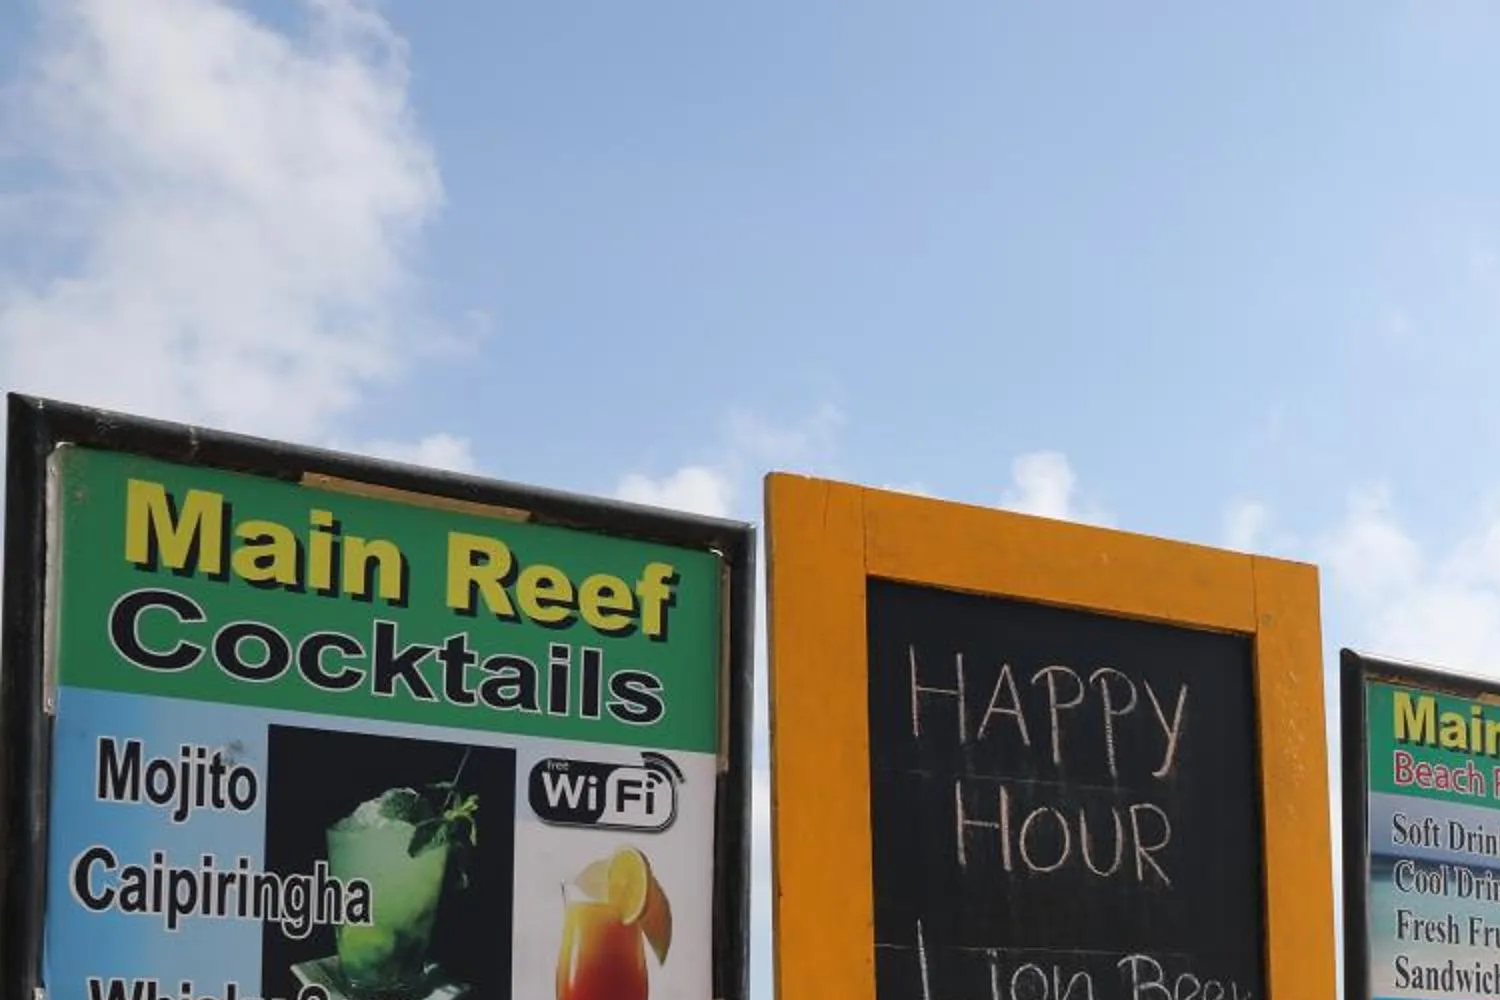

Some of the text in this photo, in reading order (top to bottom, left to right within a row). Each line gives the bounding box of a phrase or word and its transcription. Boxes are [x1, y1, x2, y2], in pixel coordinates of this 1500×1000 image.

[124, 478, 678, 641] Main Reef
[108, 588, 665, 725] Cocktails
[909, 644, 1189, 778] HAPPY
[97, 737, 259, 823] Mojito
[1393, 751, 1486, 798] Beach
[956, 780, 1172, 886] HOUR
[1392, 813, 1441, 849] Soft
[71, 846, 373, 939] Caipiringha
[1394, 860, 1450, 896] Cool
[1396, 908, 1460, 946] Fresh
